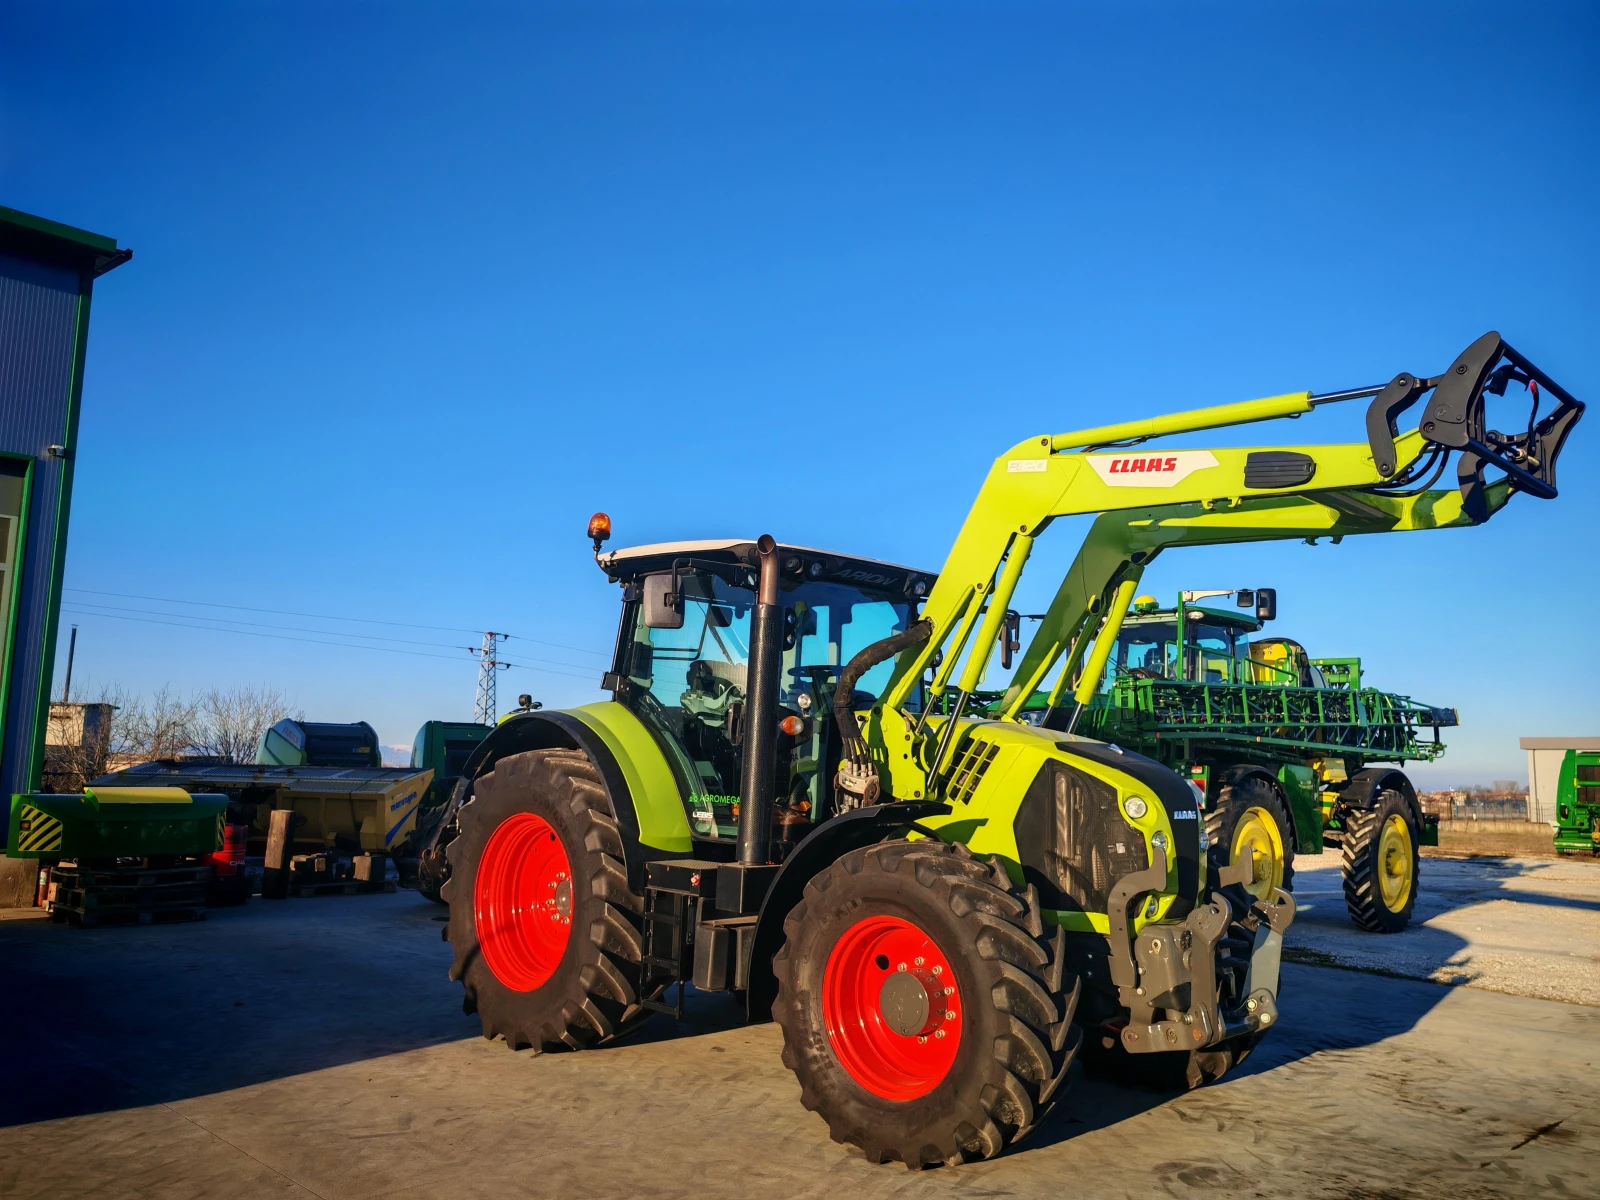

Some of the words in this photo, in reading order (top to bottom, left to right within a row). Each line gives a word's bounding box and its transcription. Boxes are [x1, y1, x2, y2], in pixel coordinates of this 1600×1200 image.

[1109, 457, 1177, 473] CLAAS
[831, 569, 899, 586] ARION
[700, 794, 740, 804] AGROMEGA
